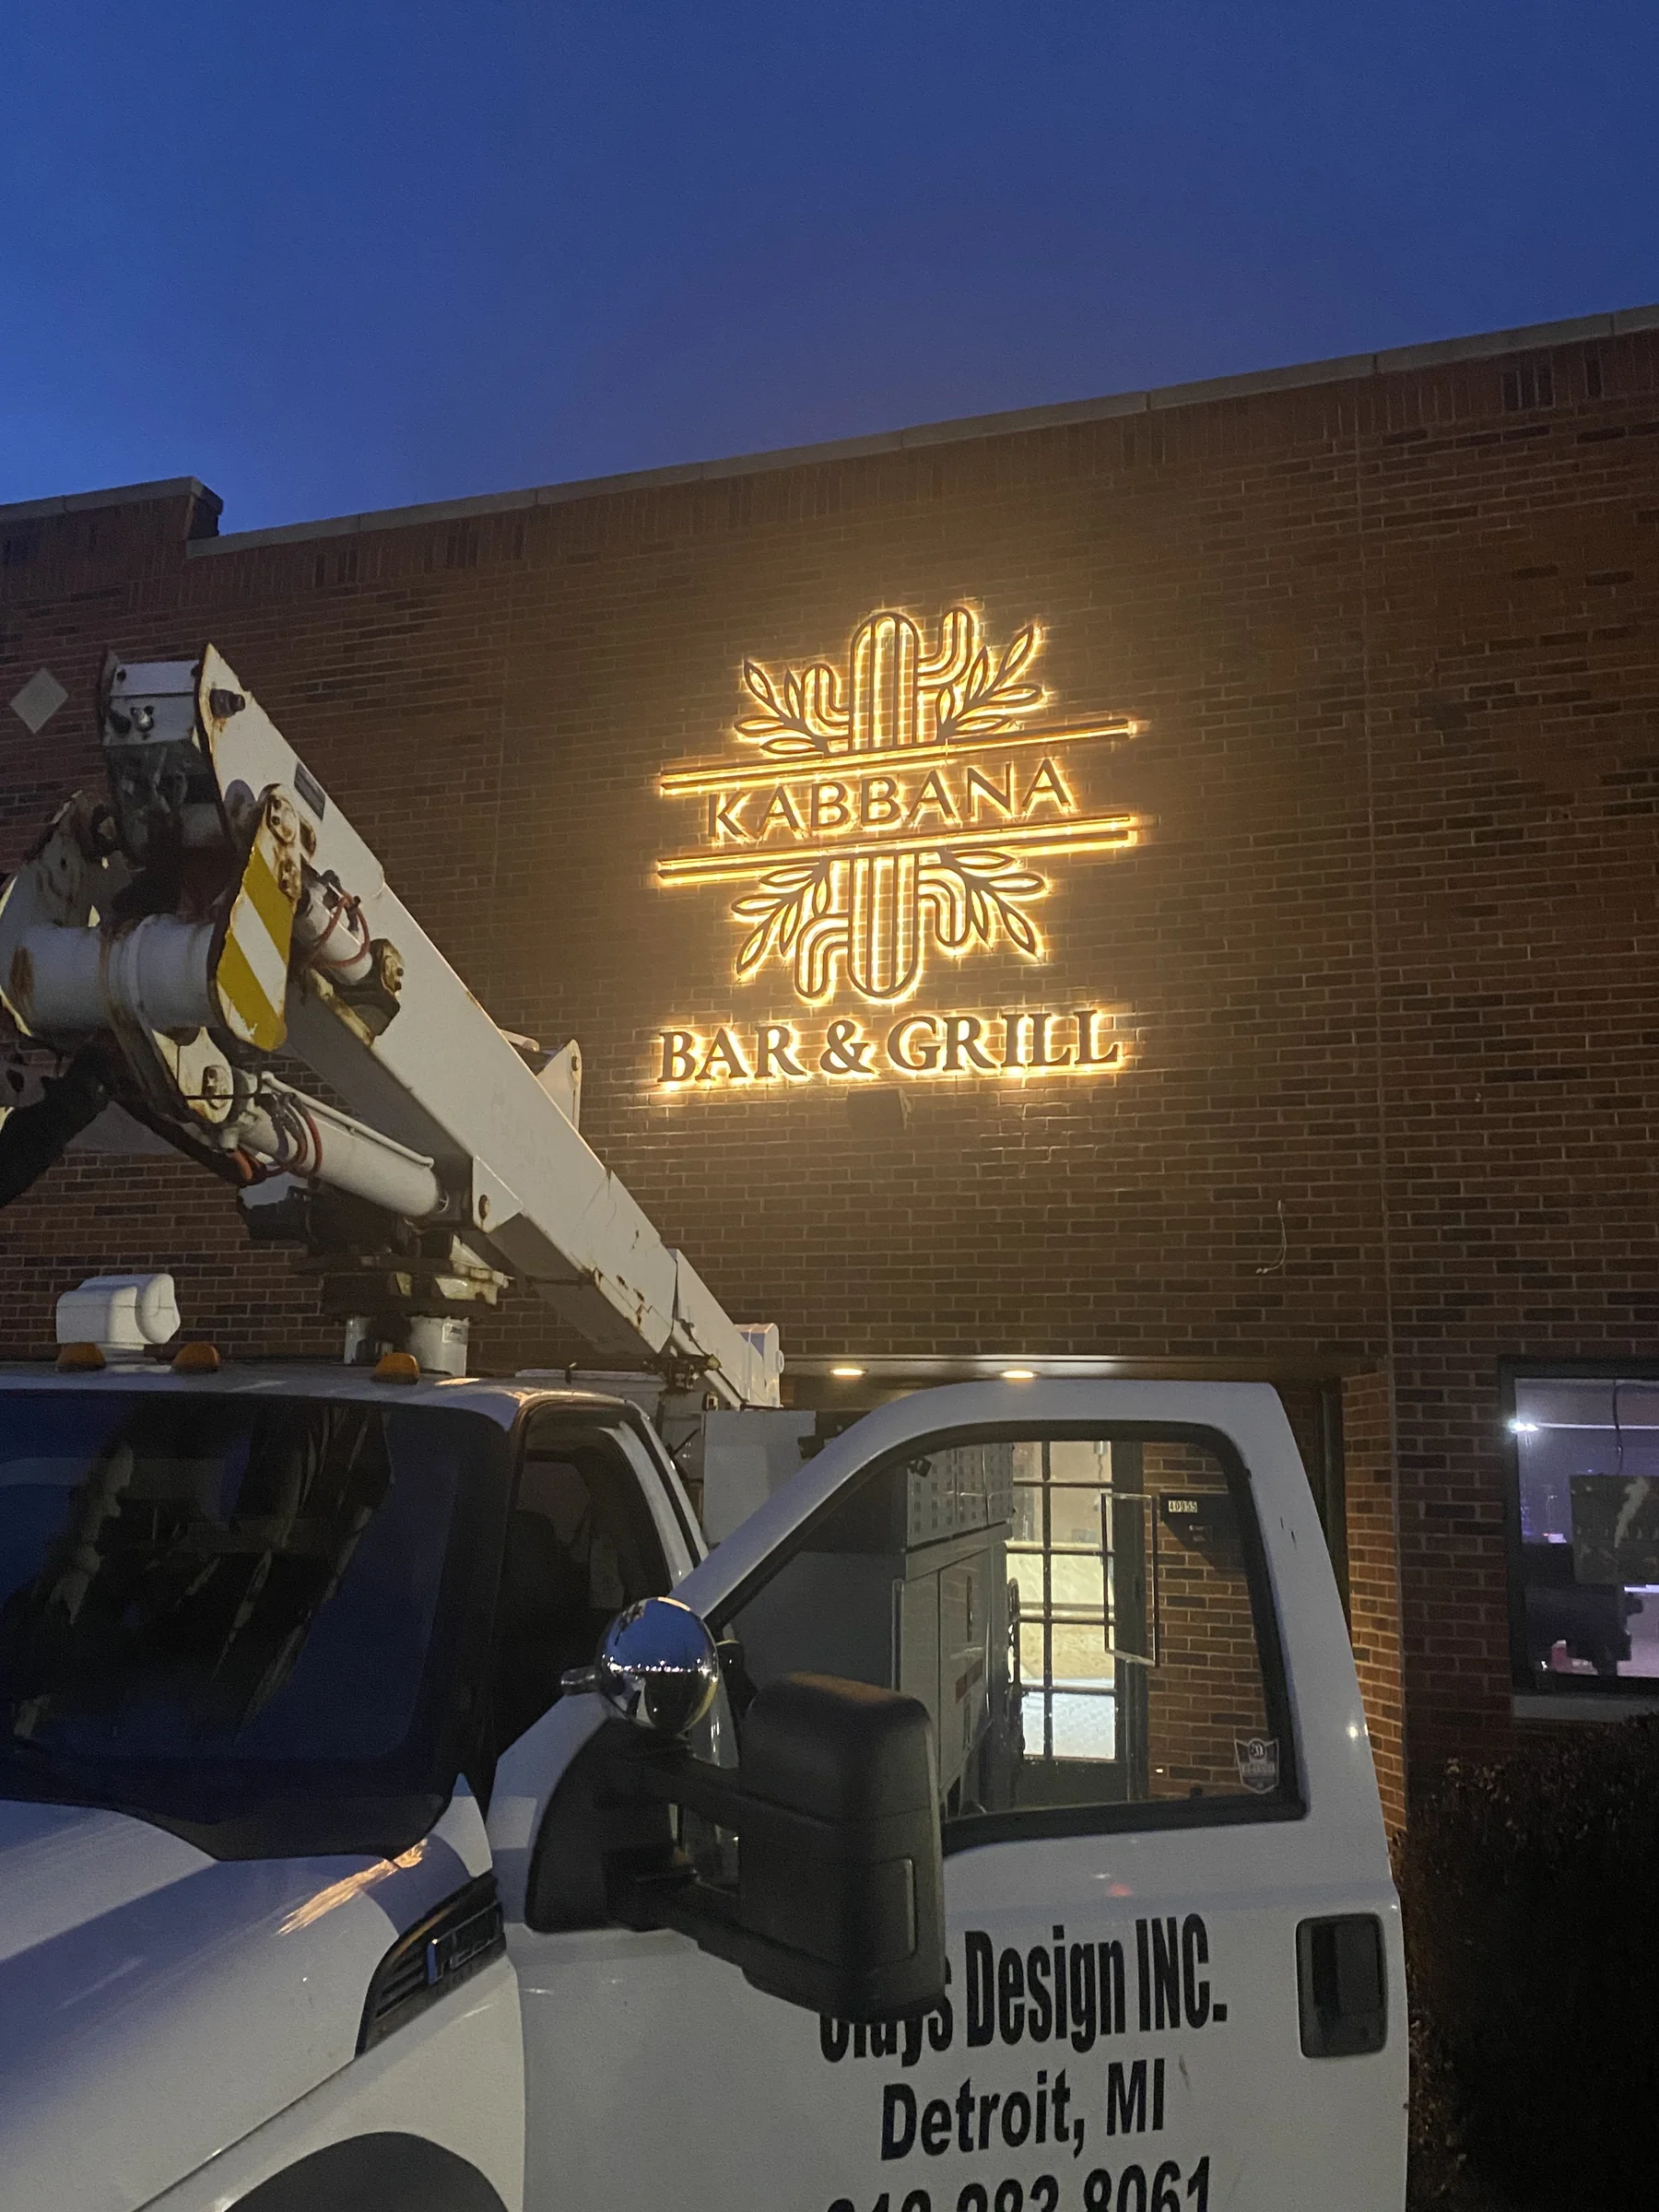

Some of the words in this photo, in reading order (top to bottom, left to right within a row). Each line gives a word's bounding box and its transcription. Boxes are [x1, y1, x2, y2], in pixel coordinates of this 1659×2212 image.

[708, 759, 1072, 838] KABBANA
[657, 1026, 807, 1082] BAR
[819, 1019, 872, 1075] &
[887, 1009, 1121, 1071] GRILL
[964, 1924, 1126, 2053] Design
[1135, 1913, 1228, 2032] INC.
[880, 2067, 1085, 2161] Detroit,
[1106, 2057, 1166, 2136] MI
